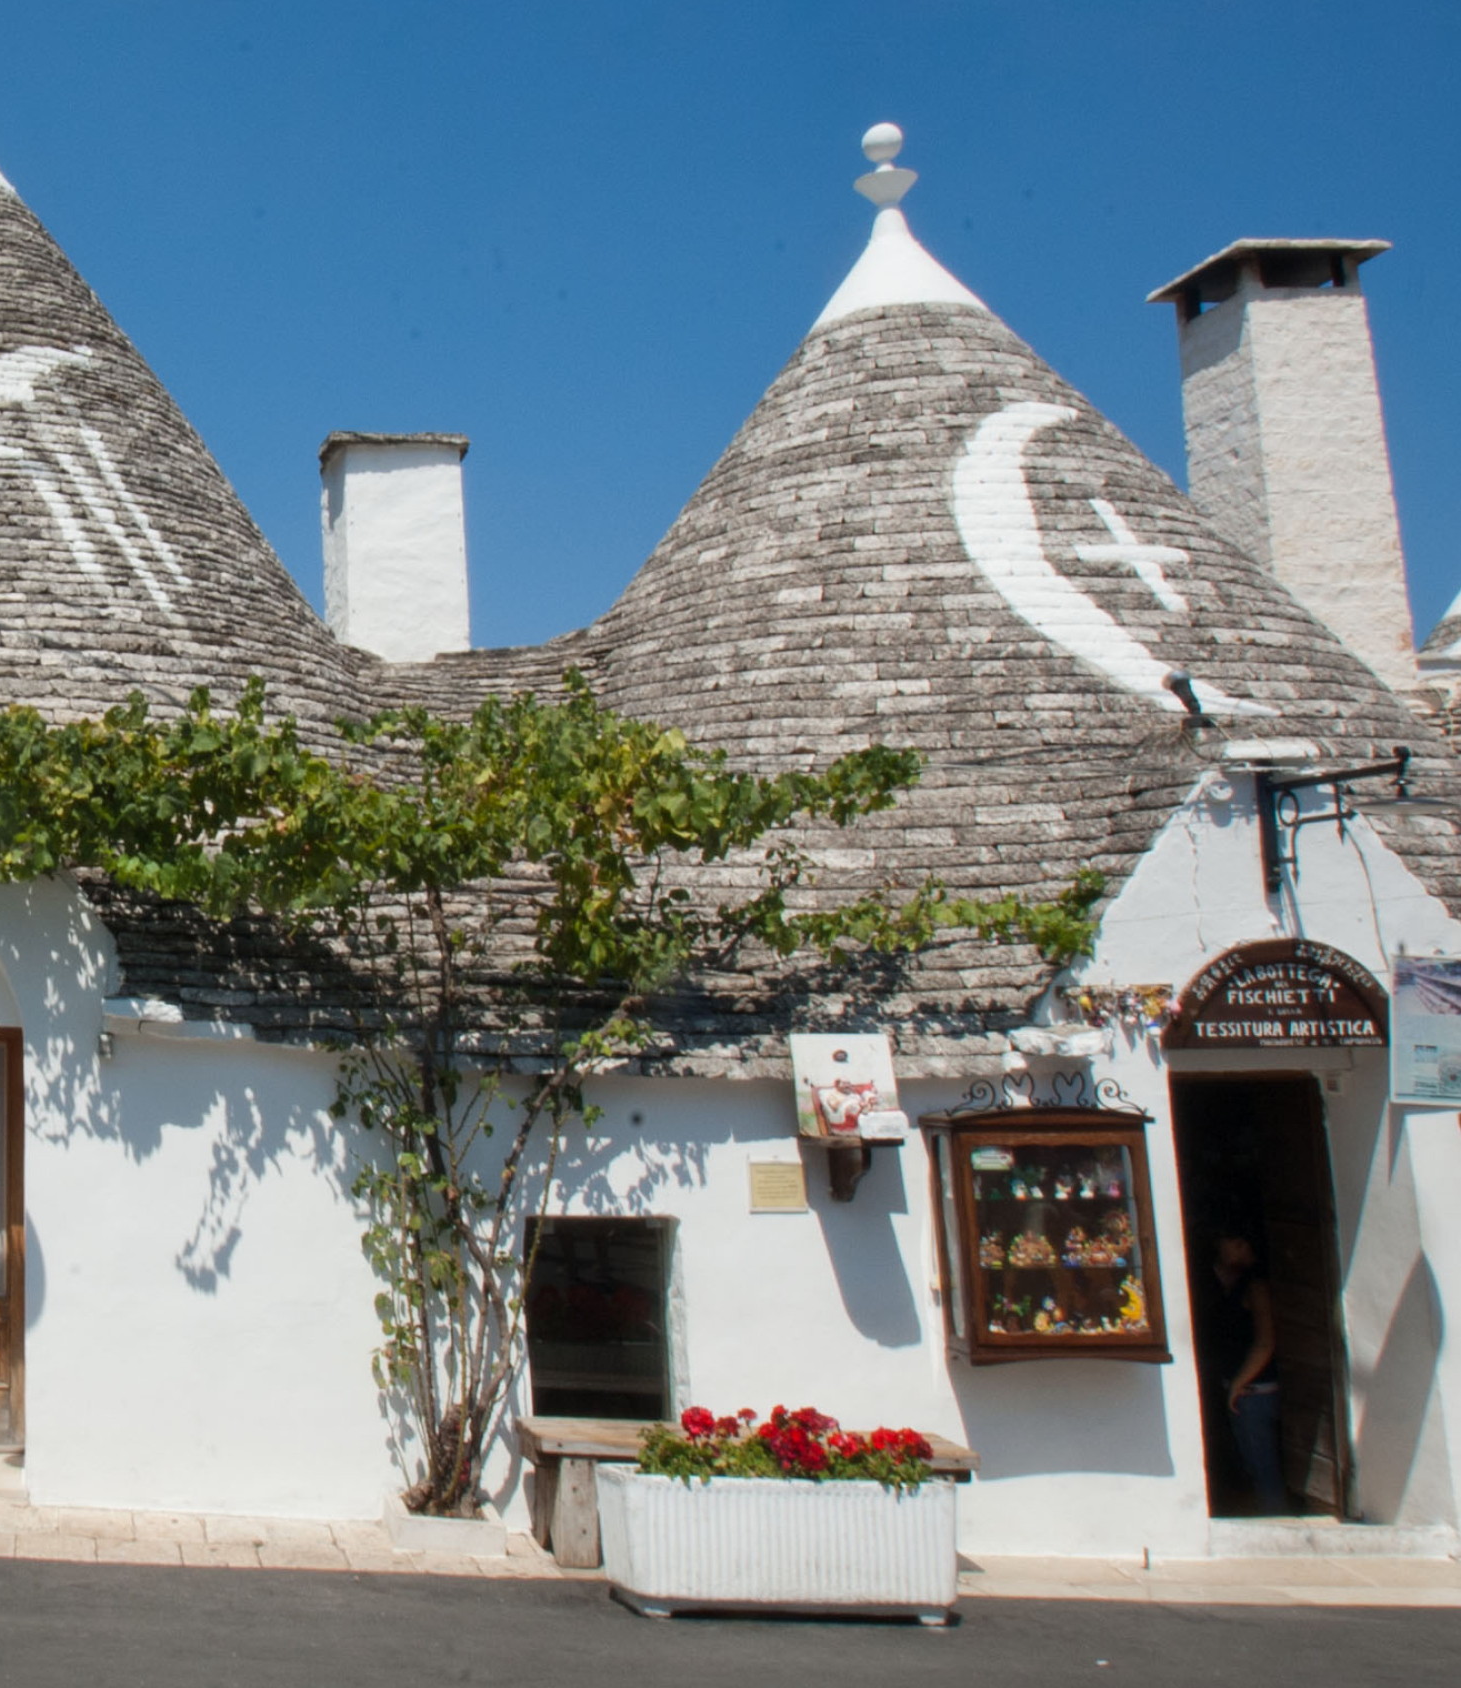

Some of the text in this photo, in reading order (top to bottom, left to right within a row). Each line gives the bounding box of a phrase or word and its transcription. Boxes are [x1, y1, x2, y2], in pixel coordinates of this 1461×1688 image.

[1226, 988, 1336, 1004] FISCHIETTI
[1194, 1019, 1375, 1037] TESSITURA ARTISTICA
